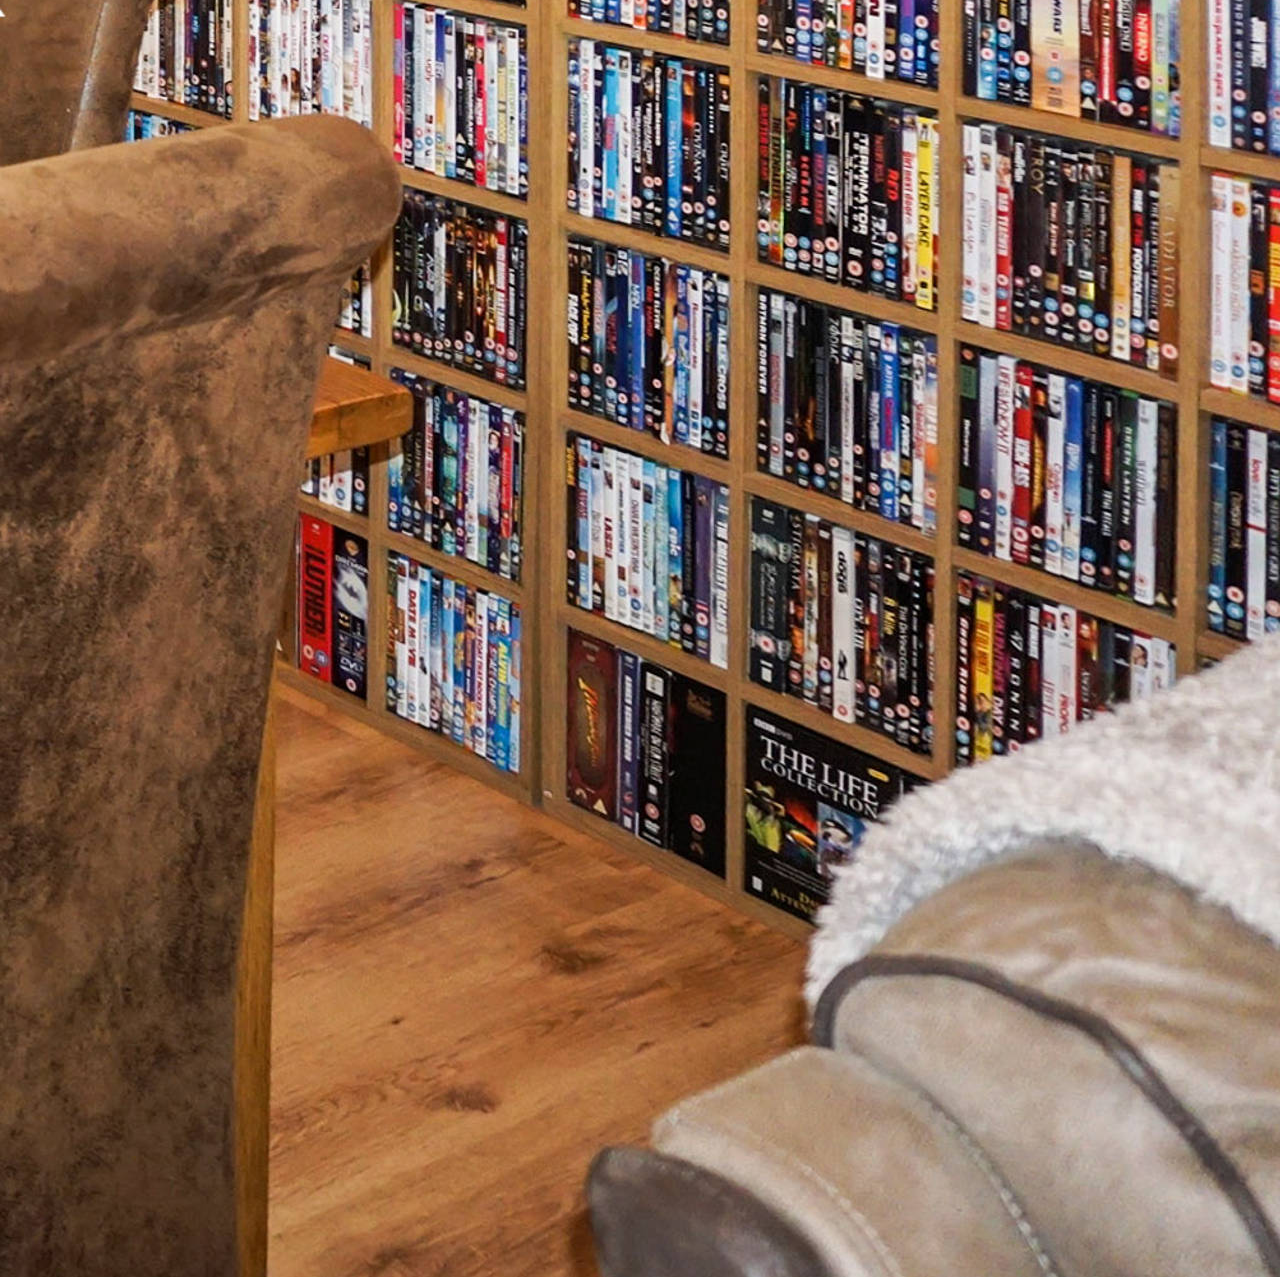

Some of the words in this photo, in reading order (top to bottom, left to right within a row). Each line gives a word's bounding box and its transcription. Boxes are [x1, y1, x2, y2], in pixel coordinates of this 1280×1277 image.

[1000, 3, 1009, 16] ME
[1136, 12, 1149, 62] INFERNO
[1235, 40, 1245, 86] WOMAN
[693, 121, 703, 183] COVENANT
[1031, 147, 1044, 195] TROY
[800, 155, 809, 207] SCREAM
[858, 136, 869, 236] TERMINATOR
[887, 169, 900, 202] RED
[920, 171, 931, 211] LAYER
[997, 192, 1009, 210] BAD
[1132, 188, 1145, 213] RISE
[920, 215, 931, 249] CAKE
[1162, 201, 1177, 309] GLADIATOR
[653, 265, 661, 298] OCEAN'S
[1132, 247, 1145, 318] FOOTSOLDIER
[567, 294, 578, 346] FACE/OFF
[653, 300, 661, 330] ELEVEN
[757, 294, 768, 342] BATMAN
[717, 328, 729, 365] ALEX
[828, 316, 841, 365] ZODIAC
[717, 366, 728, 410] CROSS
[757, 343, 767, 395] FOREVER
[997, 366, 1011, 391] LIFE
[901, 414, 910, 457] G-FORCE
[1122, 426, 1133, 466] GREEN
[1014, 437, 1031, 489] KICK-ASS
[1101, 489, 1115, 511] TOTAL
[1121, 470, 1133, 526] LANTERN
[668, 526, 680, 558] epic
[716, 520, 728, 540] THE
[1101, 512, 1114, 537] RECALL
[790, 522, 803, 591] STIGMATA
[836, 550, 849, 595] dogs
[305, 552, 327, 638] LUTHER
[408, 588, 418, 623] DATE
[884, 609, 895, 636] Mile
[959, 616, 971, 664] GHOST
[1010, 630, 1024, 654] 47
[498, 641, 509, 685] ALVIN
[959, 666, 970, 713] RIDER
[993, 695, 1006, 726] DAY
[1011, 657, 1023, 733] RONIN
[760, 735, 816, 779] THE
[822, 762, 880, 806] LIFE
[760, 757, 878, 820] COLLECTION
